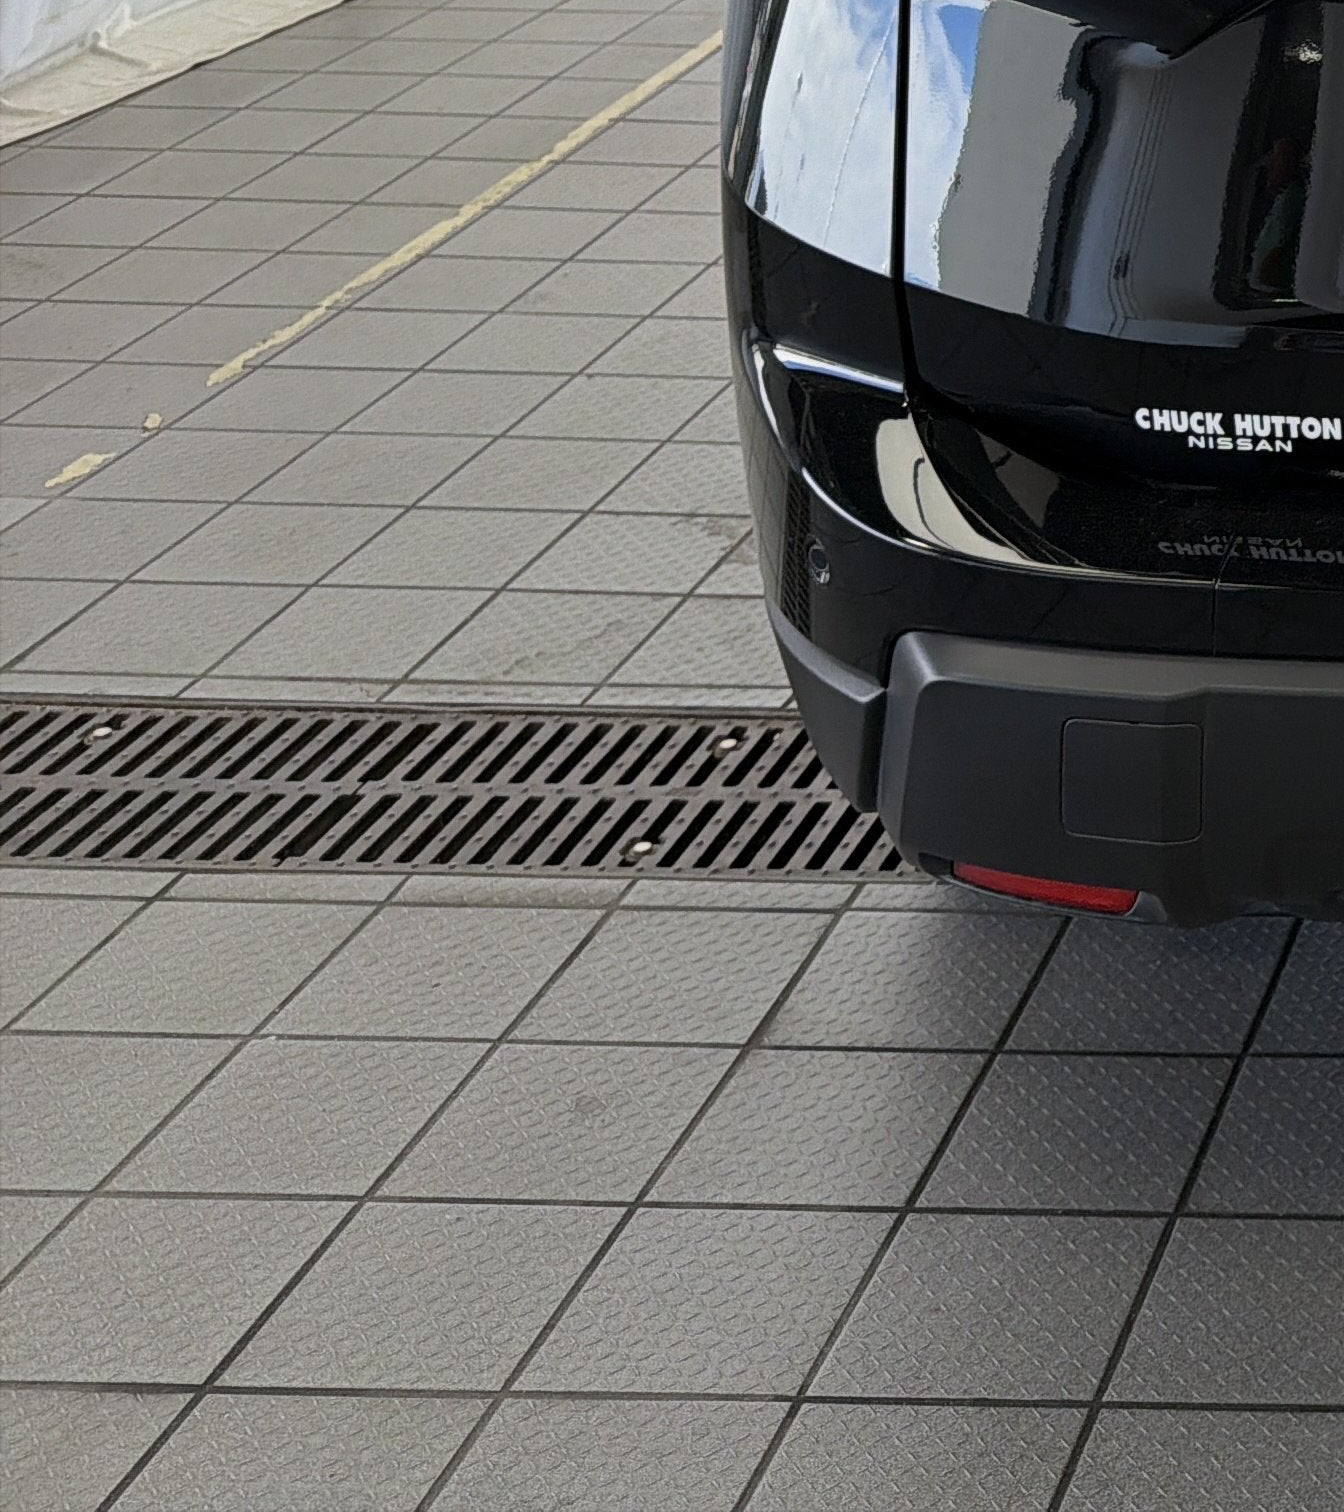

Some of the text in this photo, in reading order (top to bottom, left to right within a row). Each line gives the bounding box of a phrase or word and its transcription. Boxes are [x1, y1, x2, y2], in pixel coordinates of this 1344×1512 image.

[1134, 407, 1343, 441] CHUCK HUTTON
[1188, 436, 1293, 453] NISSAN
